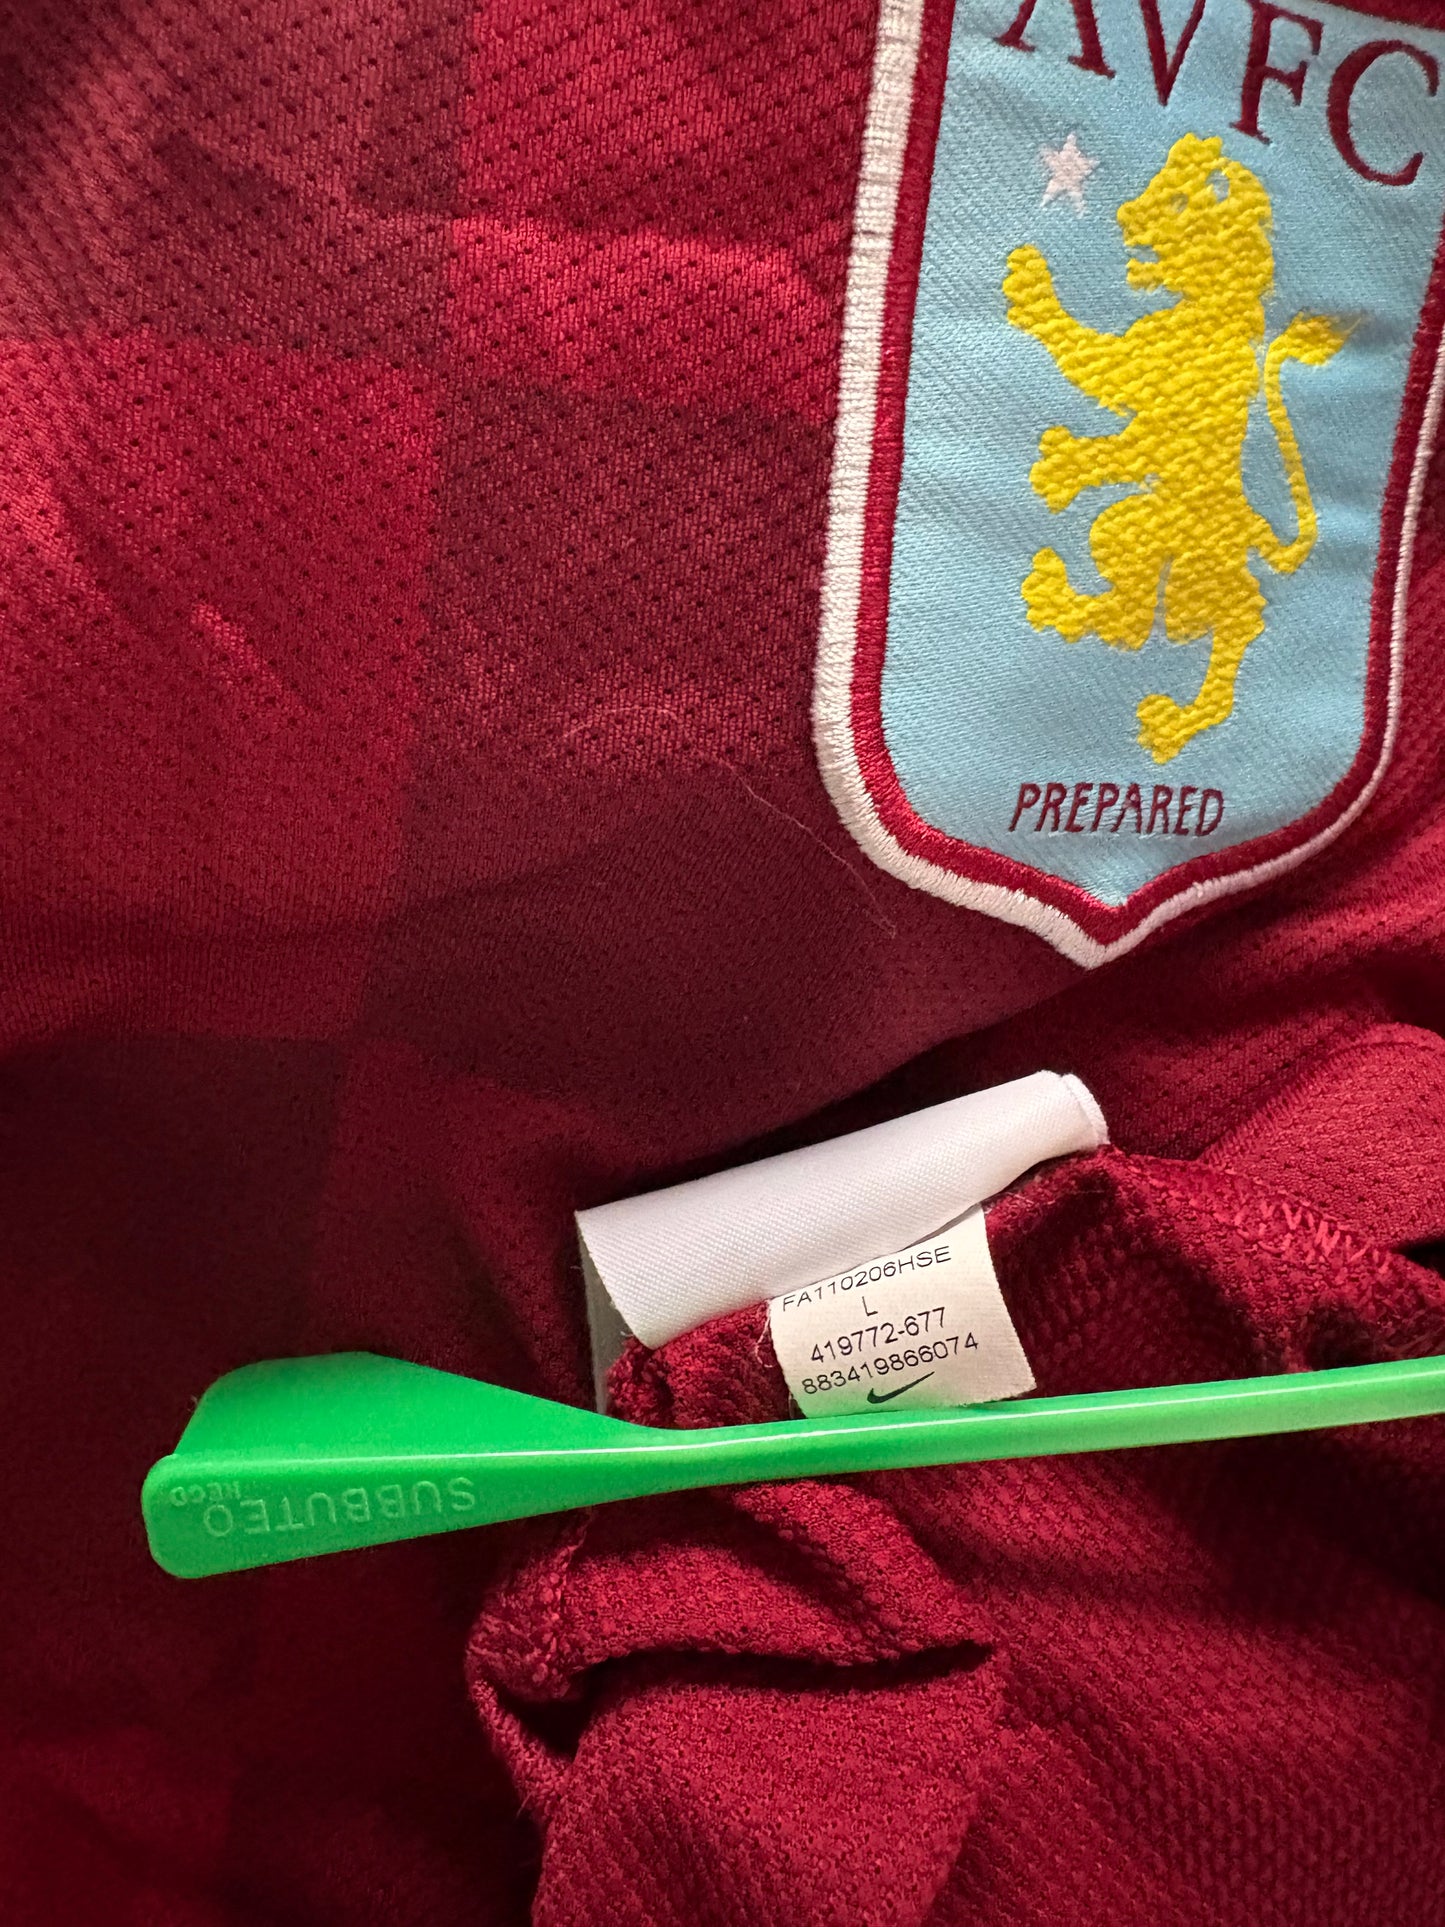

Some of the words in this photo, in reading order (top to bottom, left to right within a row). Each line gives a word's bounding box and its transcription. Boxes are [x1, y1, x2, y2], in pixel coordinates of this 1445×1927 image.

[1008, 781, 1224, 837] PREPARED
[782, 1245, 952, 1312] FA110206HSE
[862, 1296, 878, 1317] L
[801, 1332, 979, 1395] 883419866074
[810, 1307, 946, 1363] 419772-677
[203, 1476, 476, 1537] SUBBUTEO
